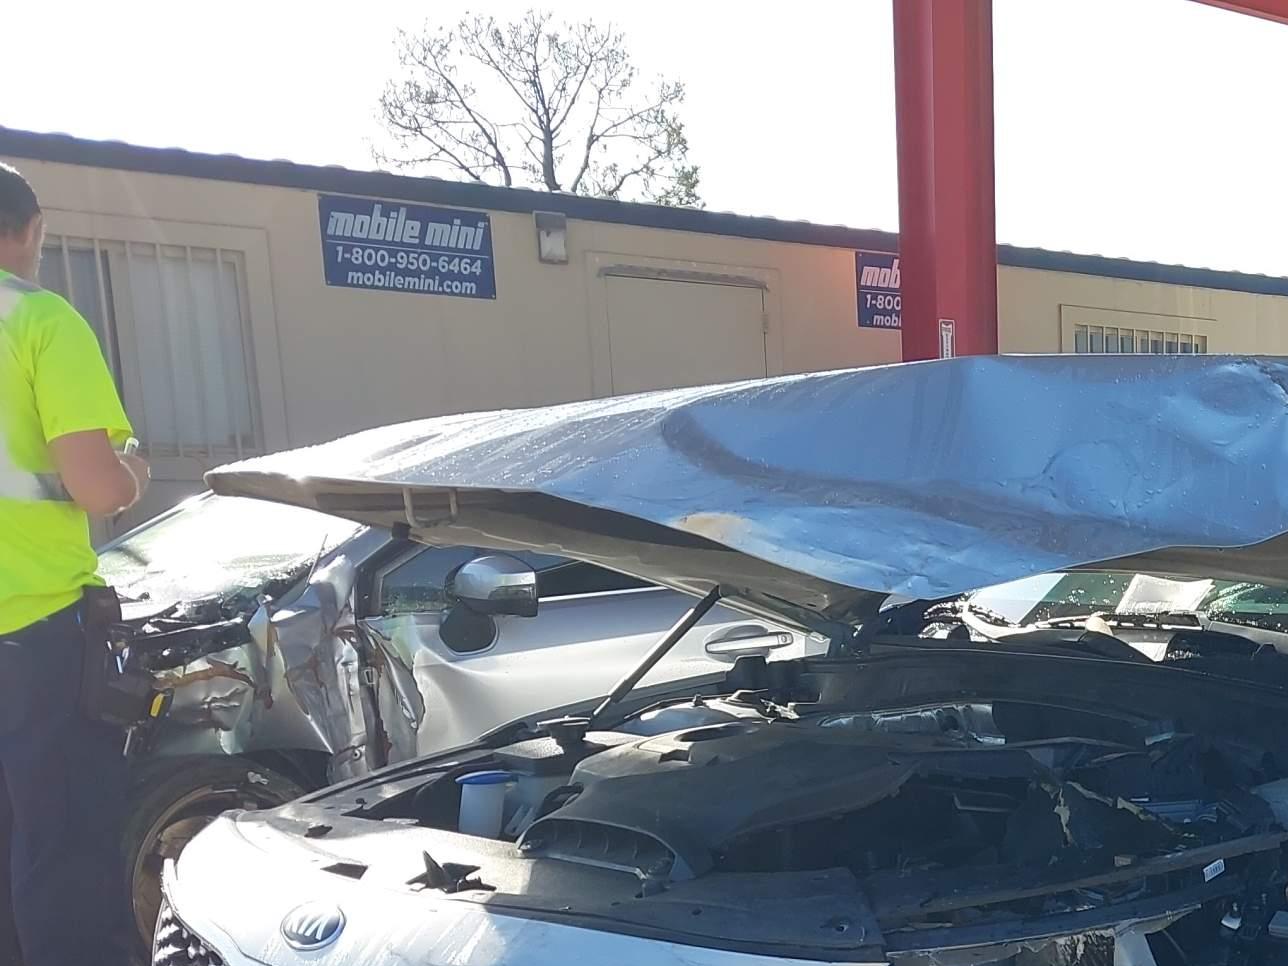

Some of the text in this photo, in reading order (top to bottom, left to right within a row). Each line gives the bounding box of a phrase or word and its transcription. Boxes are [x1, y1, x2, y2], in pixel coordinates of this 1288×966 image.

[326, 204, 486, 251] mobile mini
[335, 246, 482, 276] 1-800-950-6464
[347, 270, 477, 295] mobilemini.com
